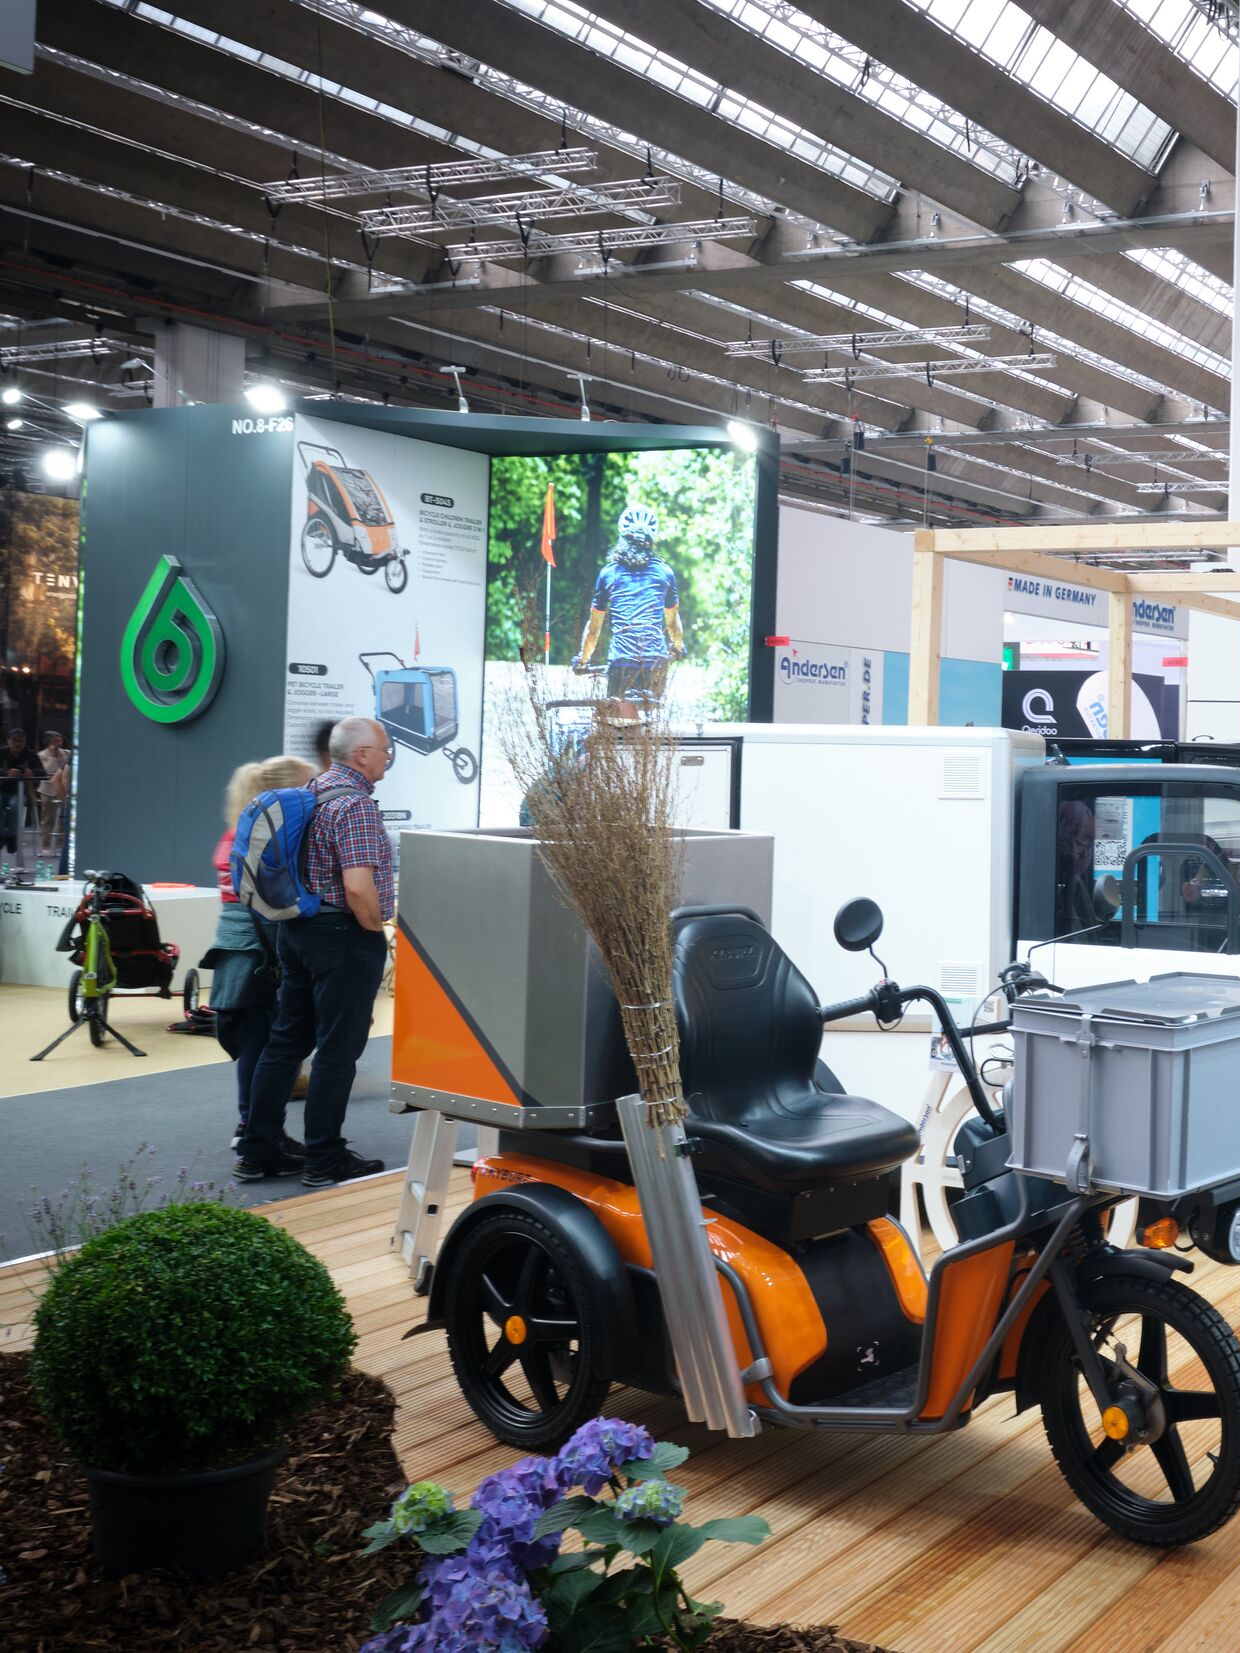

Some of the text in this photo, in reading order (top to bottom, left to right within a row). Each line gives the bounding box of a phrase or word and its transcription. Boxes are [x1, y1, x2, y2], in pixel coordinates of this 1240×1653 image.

[231, 416, 294, 434] NO.8-F26
[1013, 578, 1097, 607] MADE IN GERMANY
[1132, 598, 1175, 624] ndersen
[780, 656, 846, 680] Andersen
[0, 902, 22, 914] CLE
